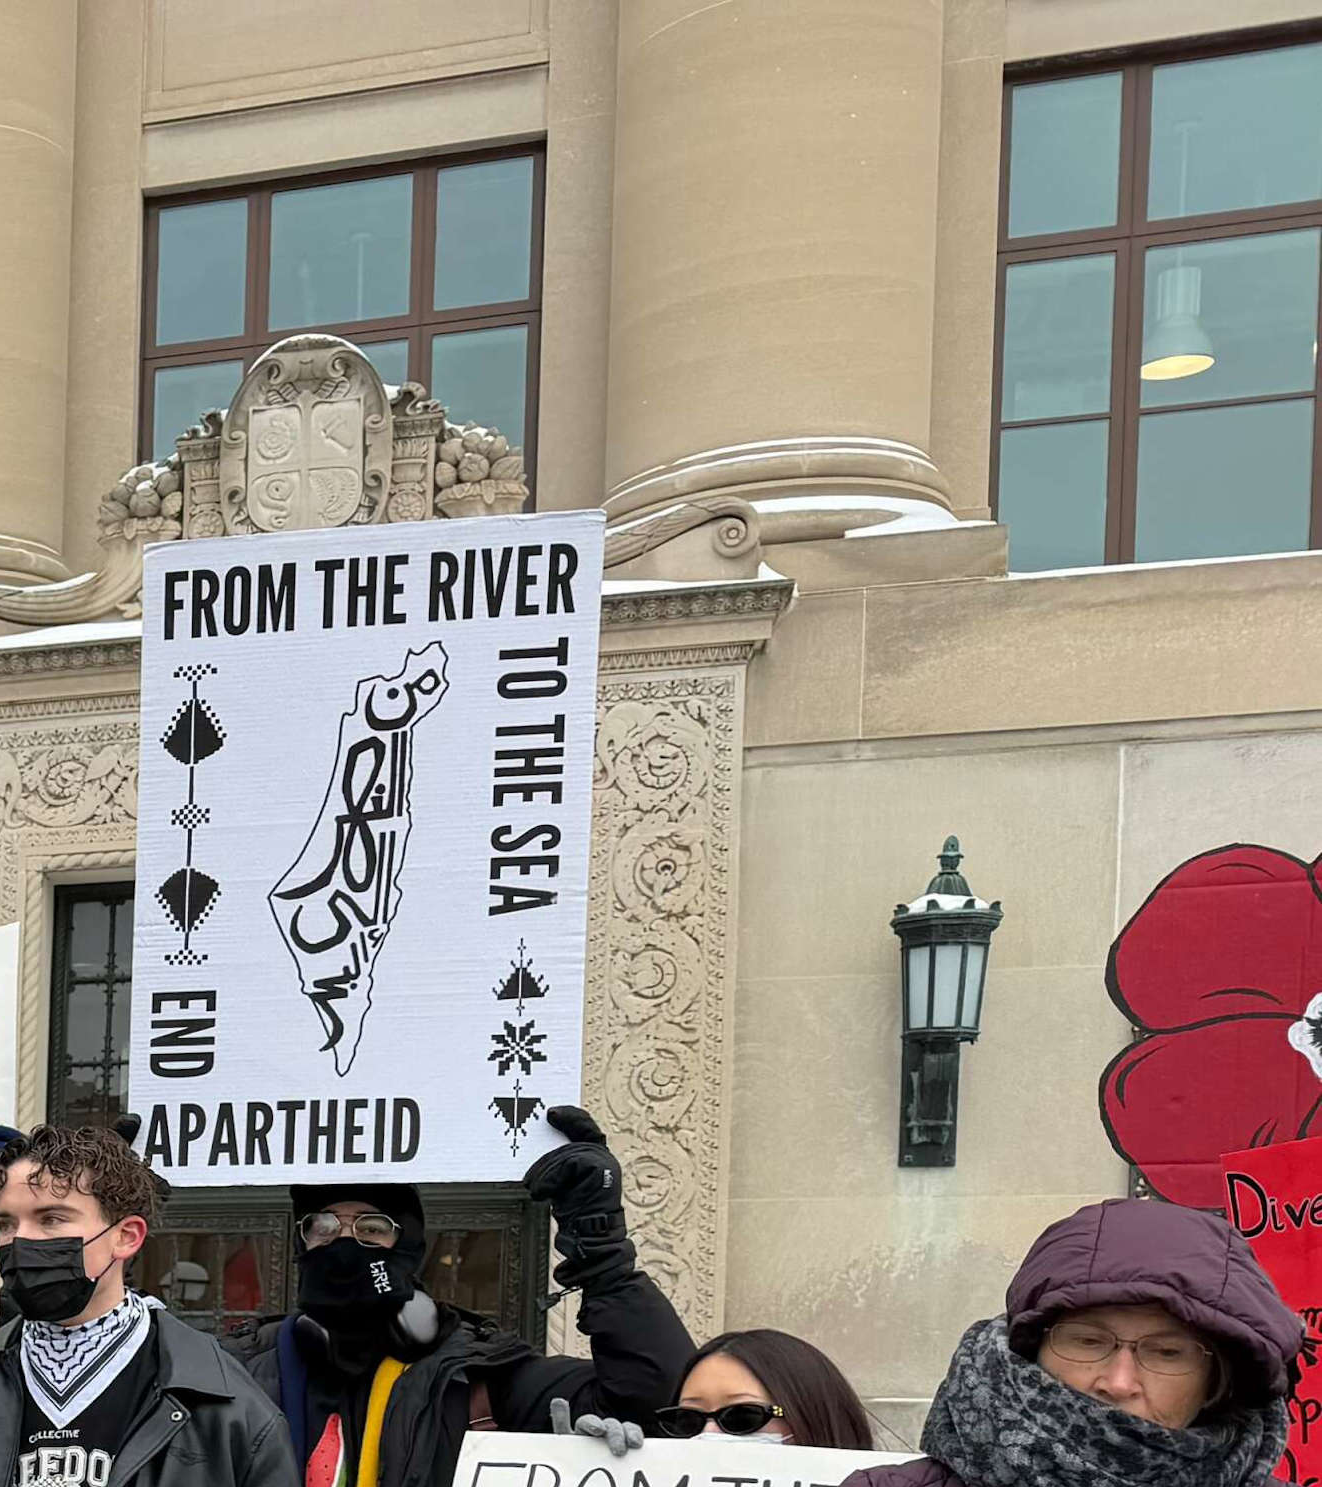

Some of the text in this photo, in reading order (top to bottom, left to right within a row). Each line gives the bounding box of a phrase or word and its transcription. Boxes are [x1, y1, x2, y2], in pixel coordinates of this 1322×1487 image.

[163, 543, 580, 640] FROM THE RIVER
[365, 669, 441, 731] من
[488, 637, 569, 917] TO THE SEA
[150, 989, 217, 1078] END
[144, 1098, 421, 1167] APARTHEID
